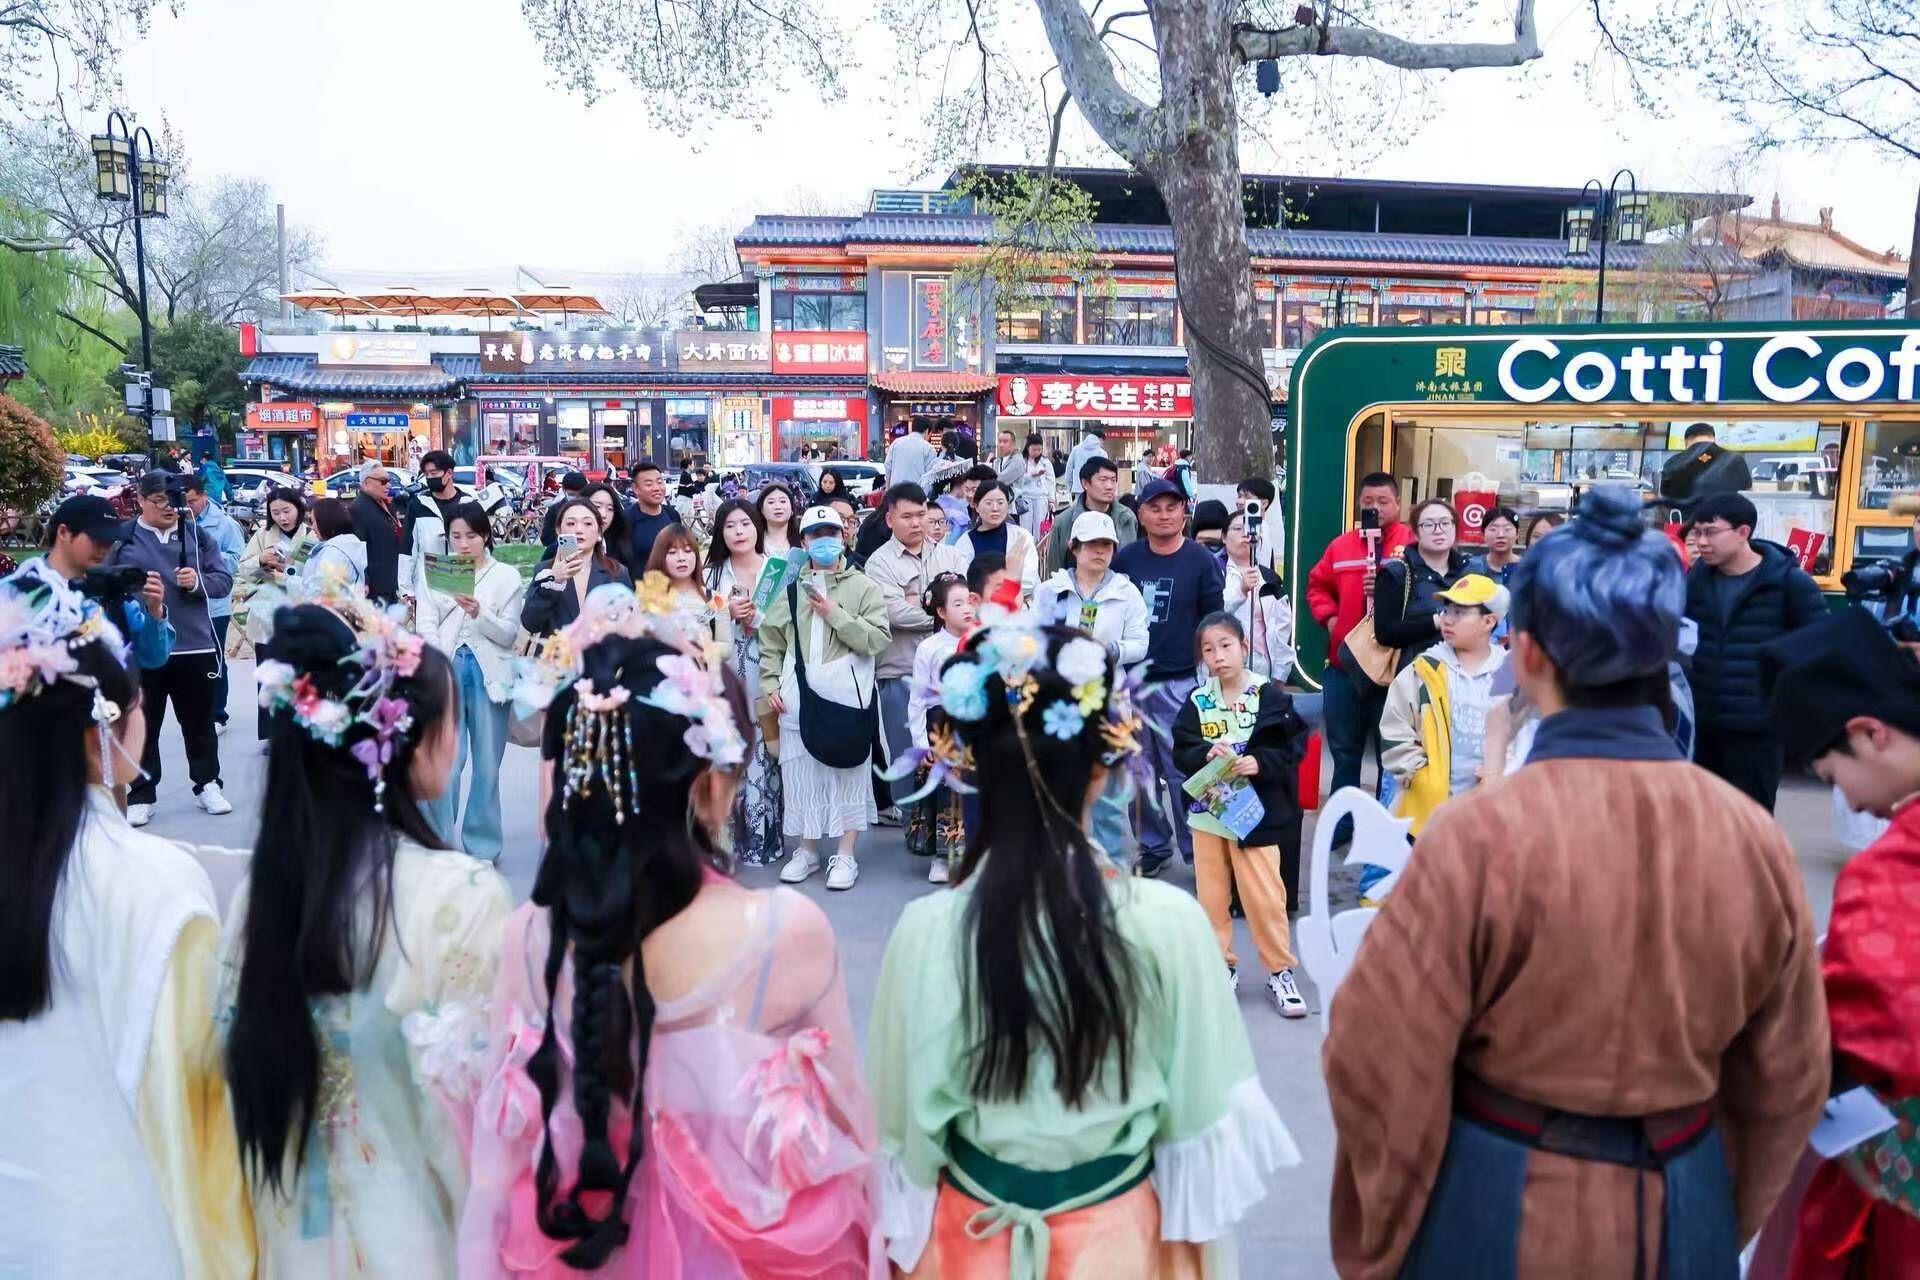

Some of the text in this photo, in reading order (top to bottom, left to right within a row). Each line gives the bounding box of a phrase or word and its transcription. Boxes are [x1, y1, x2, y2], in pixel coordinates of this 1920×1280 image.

[1498, 335, 1920, 403] Cotti Cof
[1040, 381, 1141, 412] 李先生
[1427, 393, 1455, 401] JINAN
[1143, 397, 1175, 412] 大王
[258, 408, 313, 423] 烟酒超市
[817, 509, 826, 519] C
